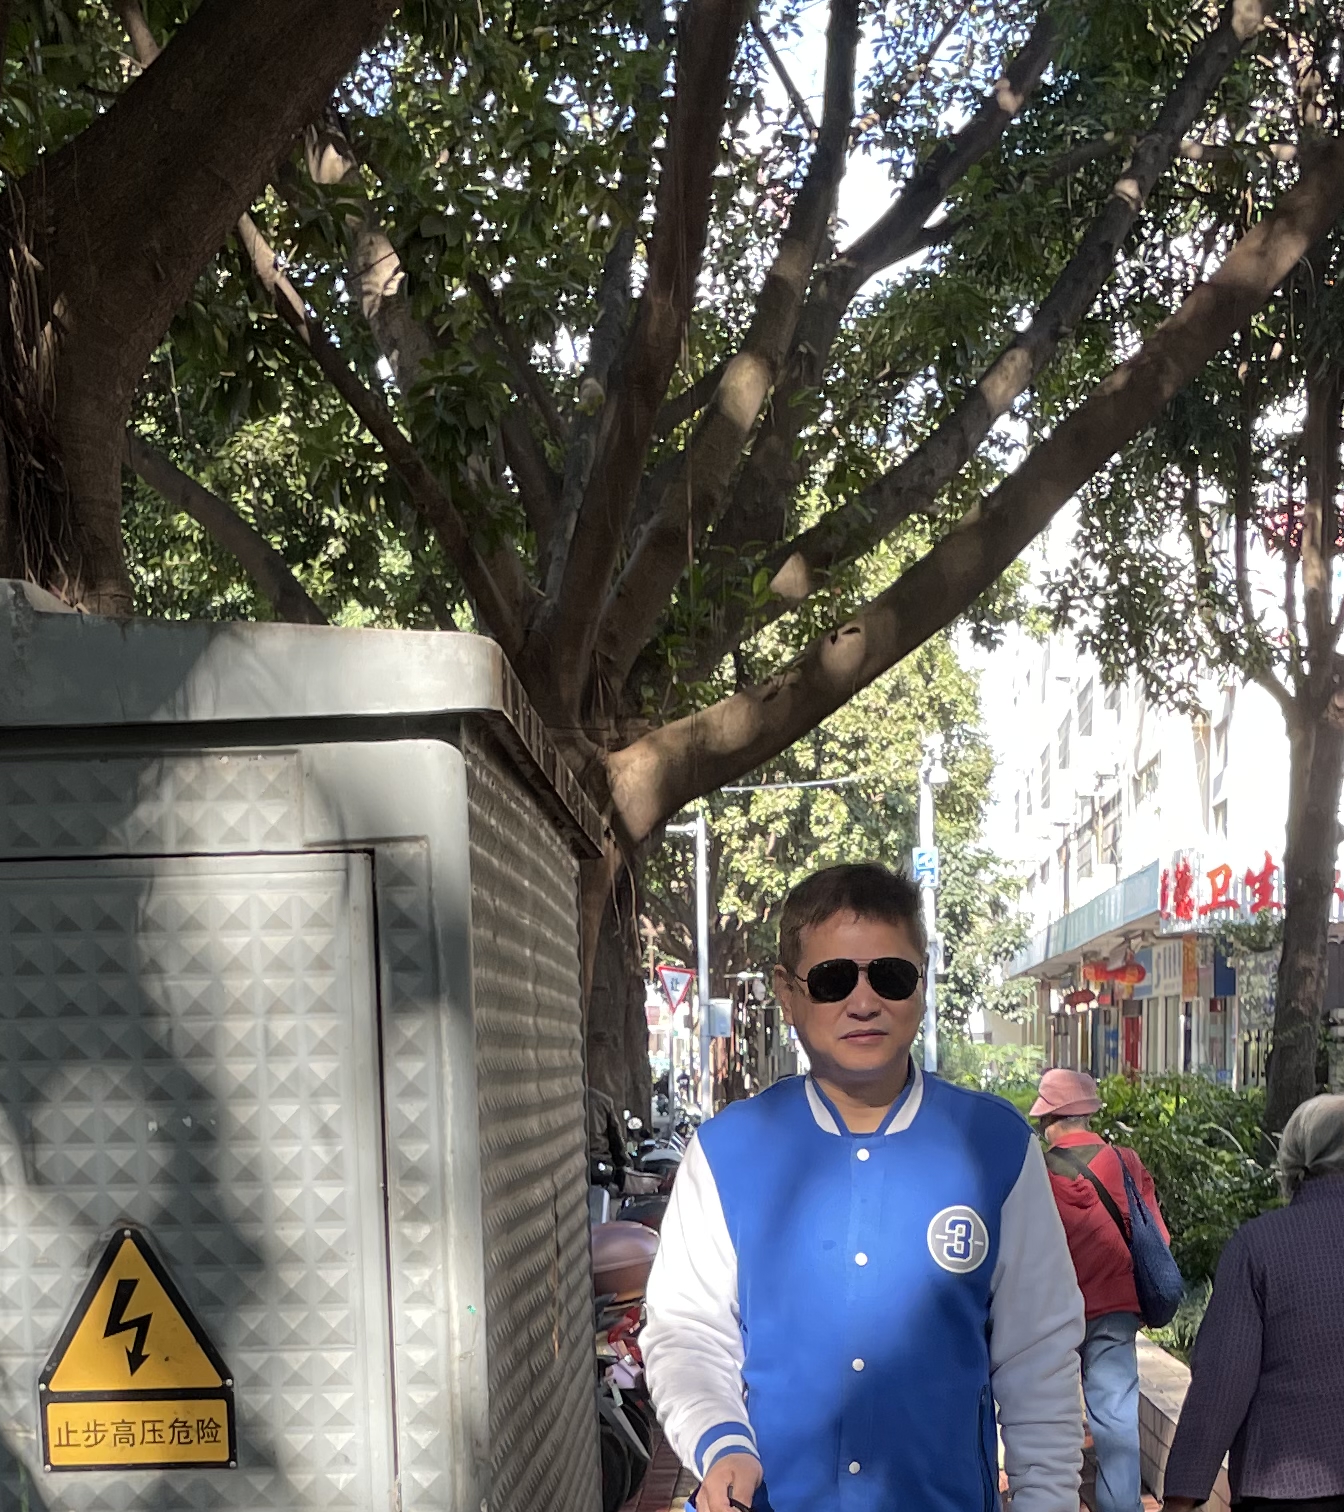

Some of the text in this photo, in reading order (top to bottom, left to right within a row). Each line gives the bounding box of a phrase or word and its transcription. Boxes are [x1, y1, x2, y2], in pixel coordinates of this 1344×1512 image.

[943, 1215, 975, 1262] 3
[54, 1417, 223, 1448] 止步高压危险
